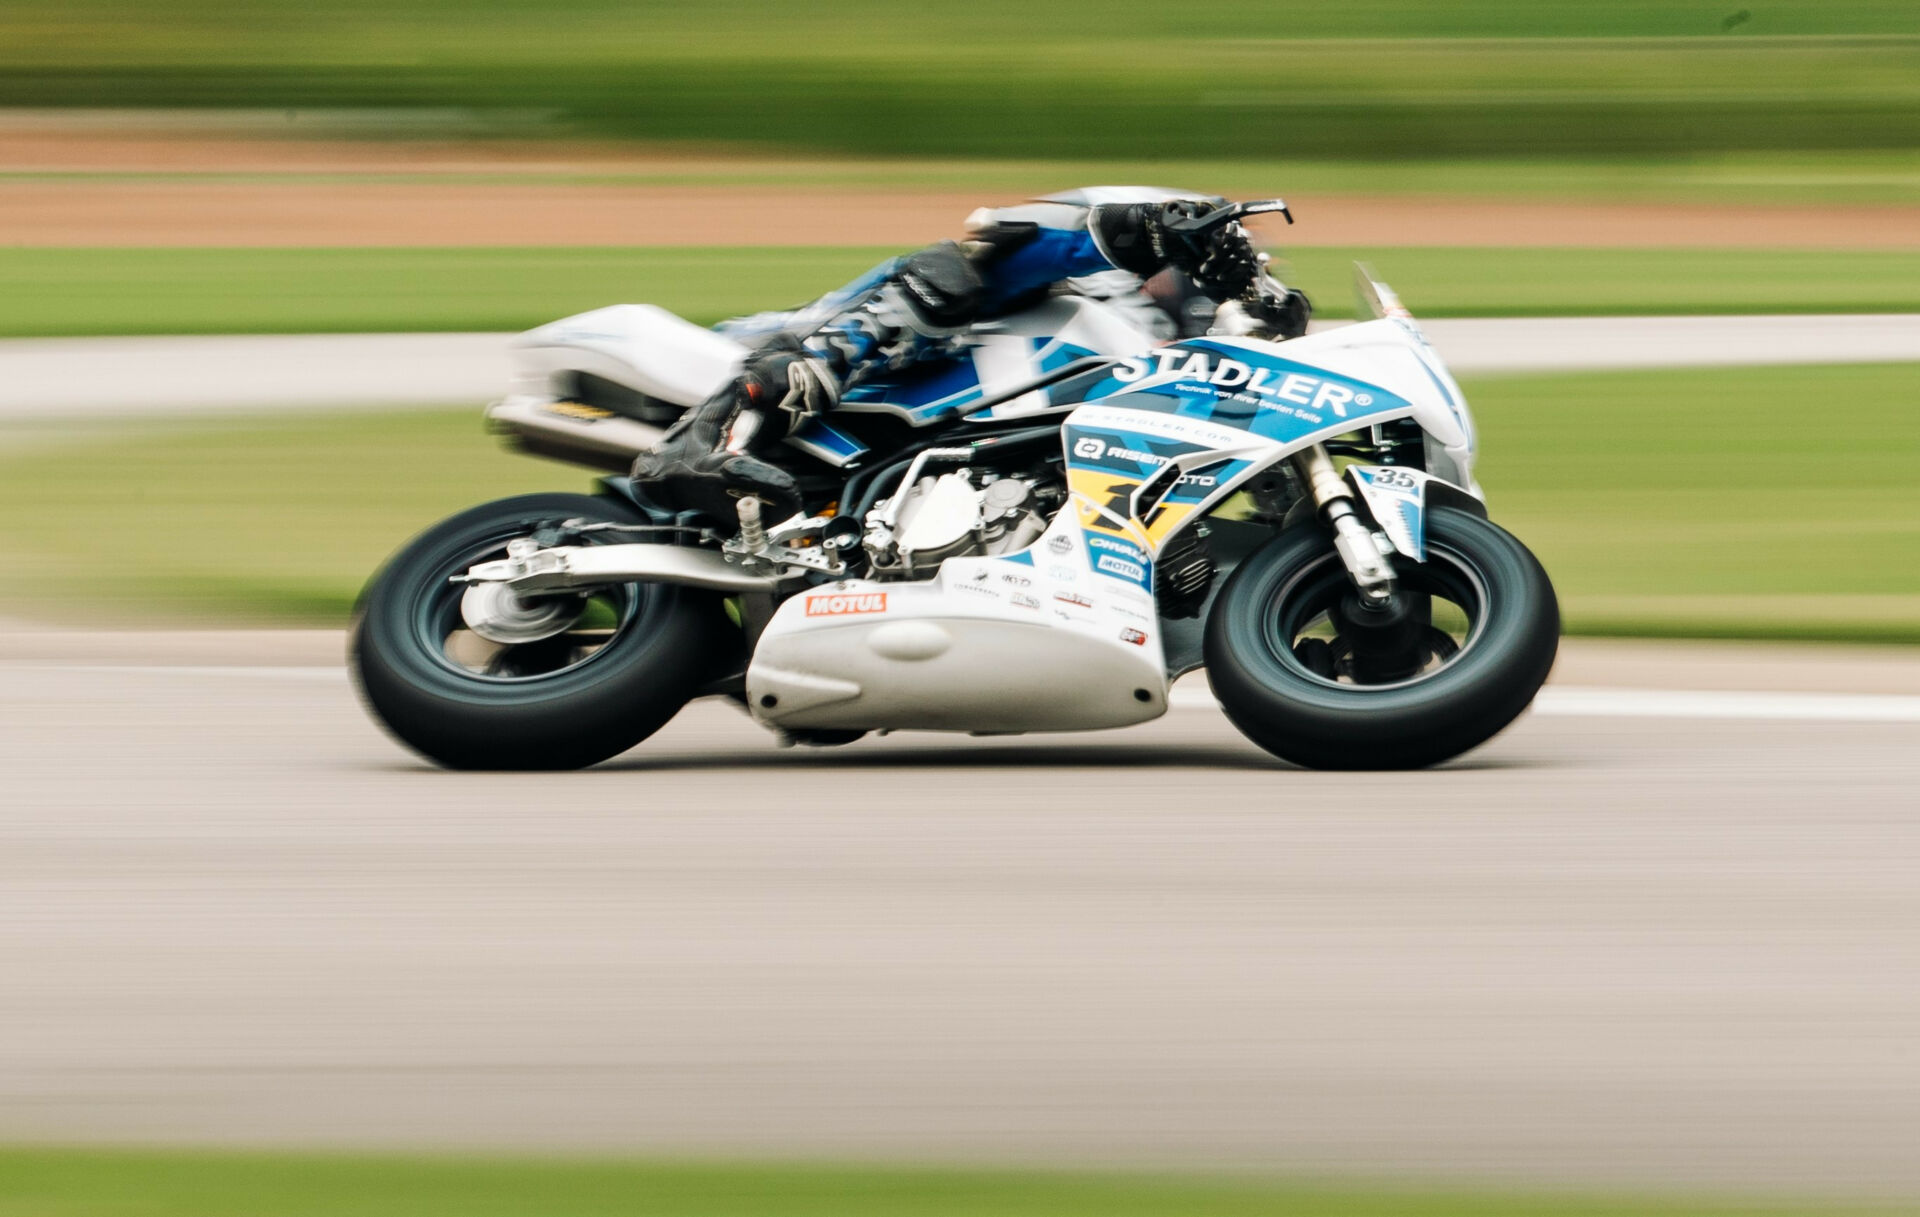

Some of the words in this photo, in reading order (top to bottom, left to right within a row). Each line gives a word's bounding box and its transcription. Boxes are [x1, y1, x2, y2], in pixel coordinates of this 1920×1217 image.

[1174, 383, 1211, 395] Technik
[1213, 389, 1232, 399] von
[1232, 392, 1260, 405] Ihrer
[1258, 399, 1294, 416] besten
[1294, 408, 1323, 424] Seite
[1375, 468, 1416, 488] 35
[1101, 559, 1141, 577] MOTUL
[808, 595, 884, 615] MOTUL
